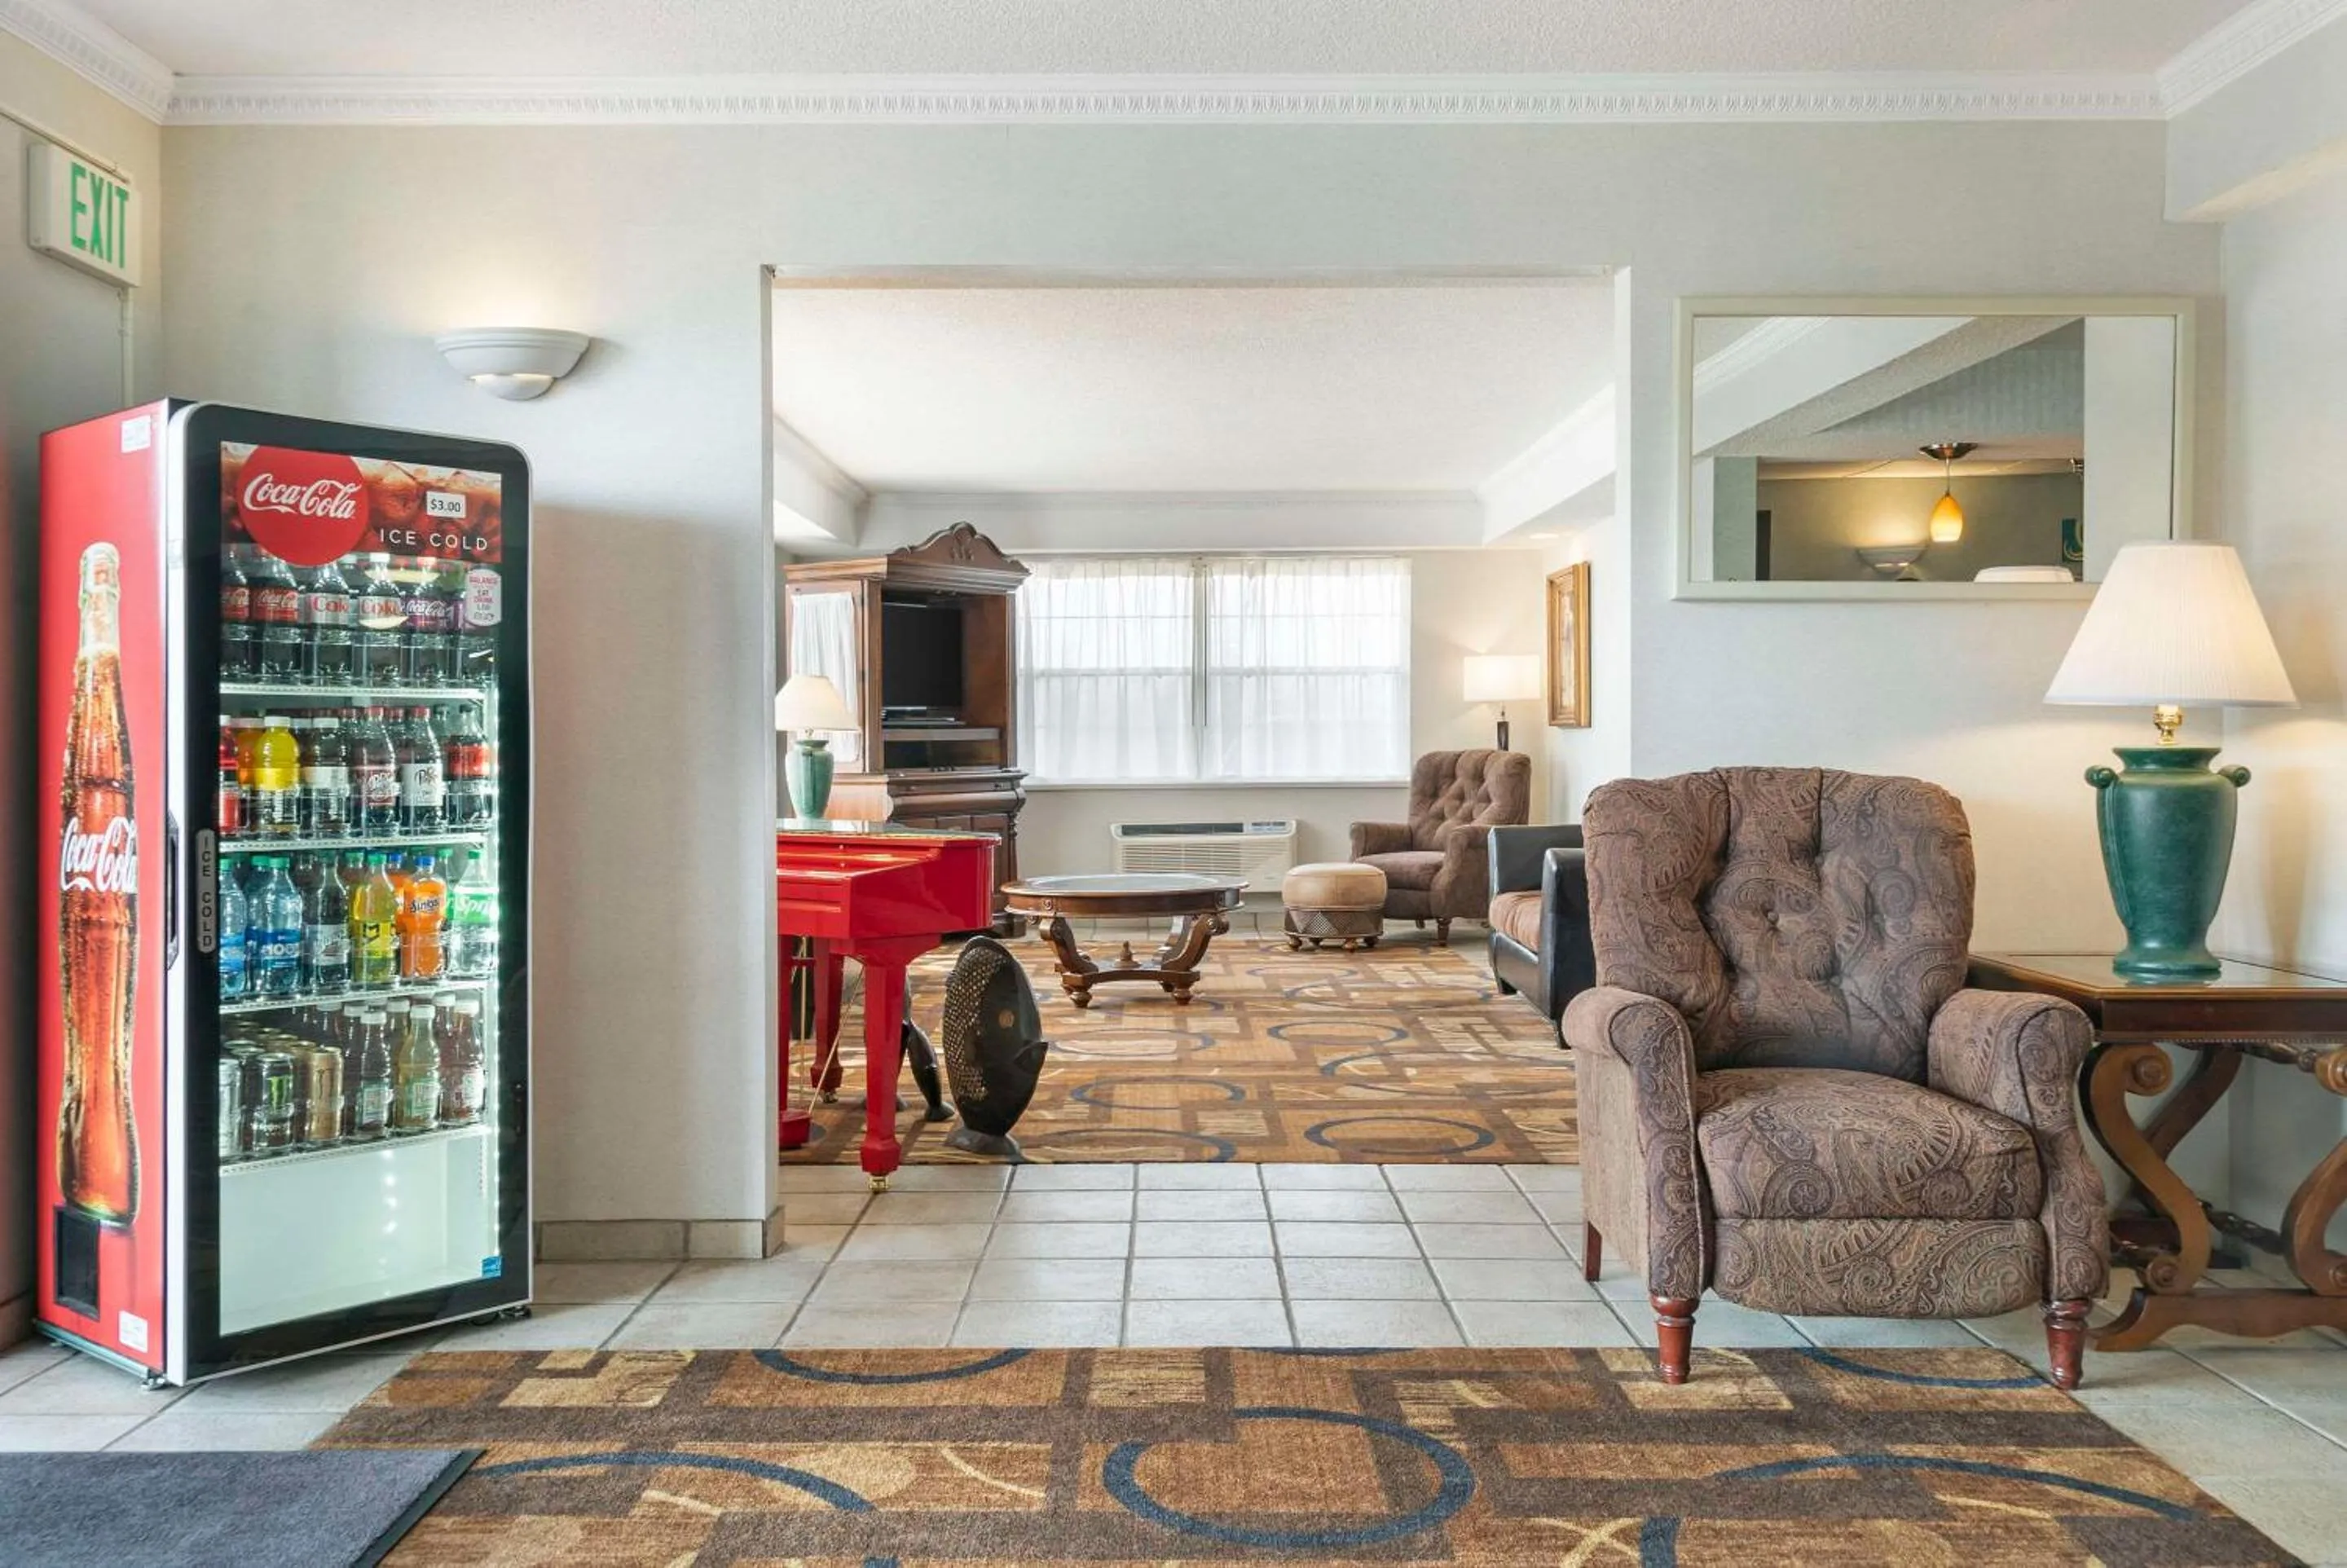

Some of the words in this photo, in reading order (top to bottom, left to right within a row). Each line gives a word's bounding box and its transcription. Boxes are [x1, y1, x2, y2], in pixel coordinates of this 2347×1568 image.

[71, 161, 130, 268] EXIT
[244, 473, 362, 519] Coca-Cola
[430, 498, 460, 513] $3.00
[380, 528, 416, 544] ICE
[429, 533, 487, 551] COLD
[202, 836, 212, 878] ICE
[201, 892, 213, 947] COLD
